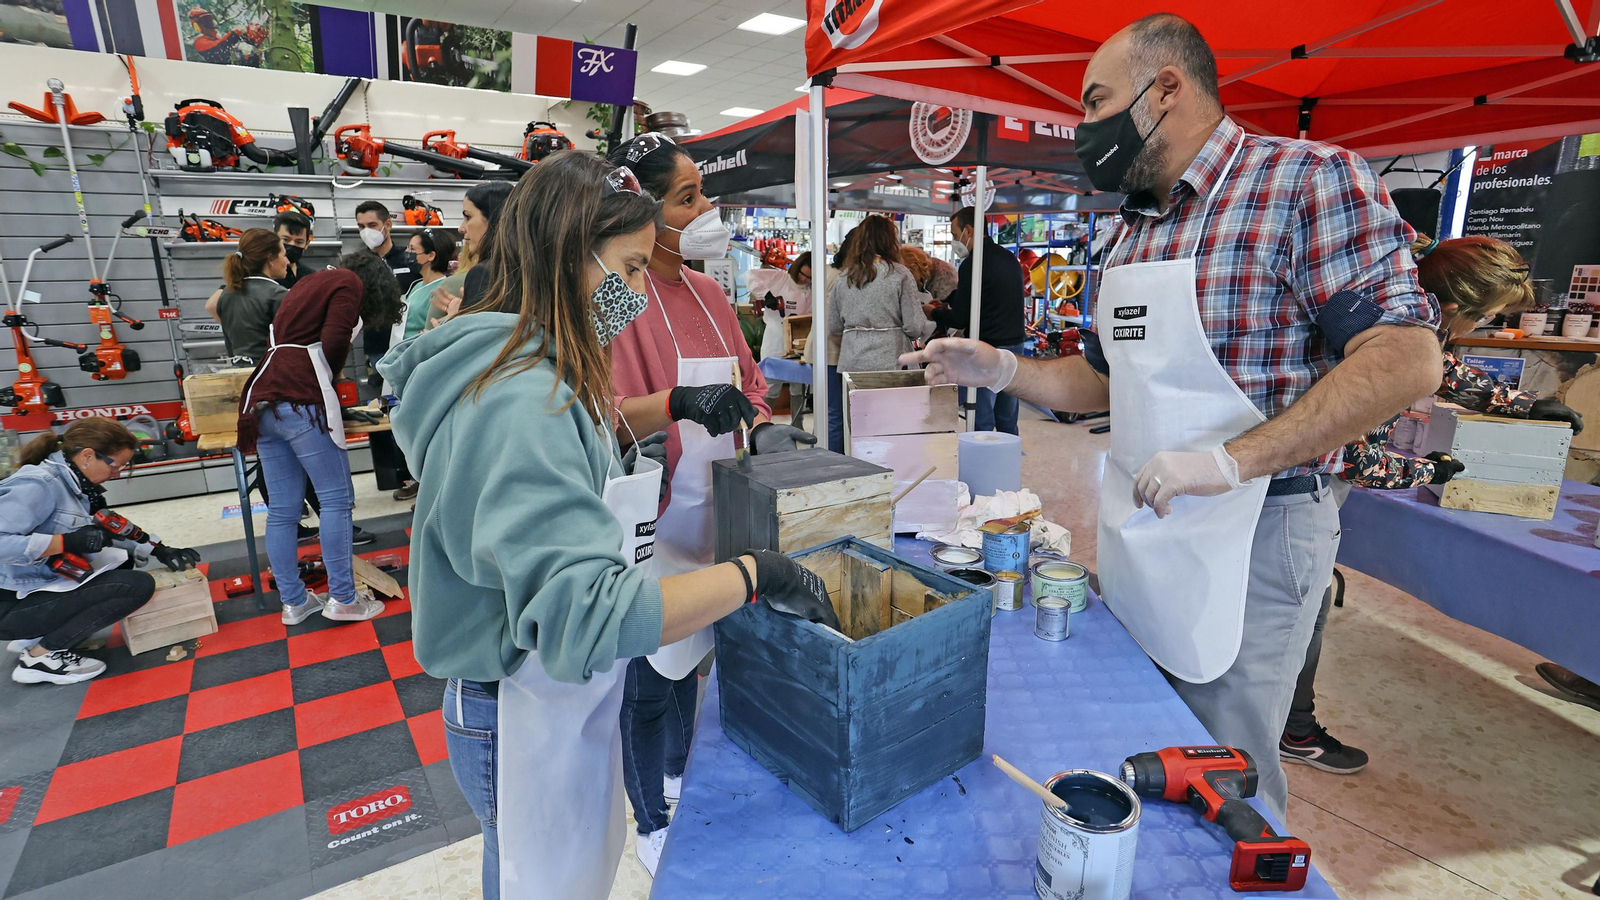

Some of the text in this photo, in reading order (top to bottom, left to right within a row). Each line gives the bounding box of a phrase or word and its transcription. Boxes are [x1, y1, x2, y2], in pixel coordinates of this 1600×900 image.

[1035, 121, 1076, 141] Ein
[1096, 144, 1119, 167] AkzoNobel
[1493, 149, 1528, 161] marca
[1476, 163, 1507, 176] de los
[1473, 174, 1553, 193] profesionales.
[1469, 208, 1499, 216] Santiago
[1490, 223, 1542, 232] Metropolitano
[1117, 307, 1141, 317] xylazel
[1114, 328, 1144, 338] OXIRITE
[55, 405, 152, 421] HONDA
[639, 523, 657, 534] xyla
[636, 545, 655, 560] OXIR
[333, 794, 404, 825] TORO
[327, 813, 422, 849] Count on it.
